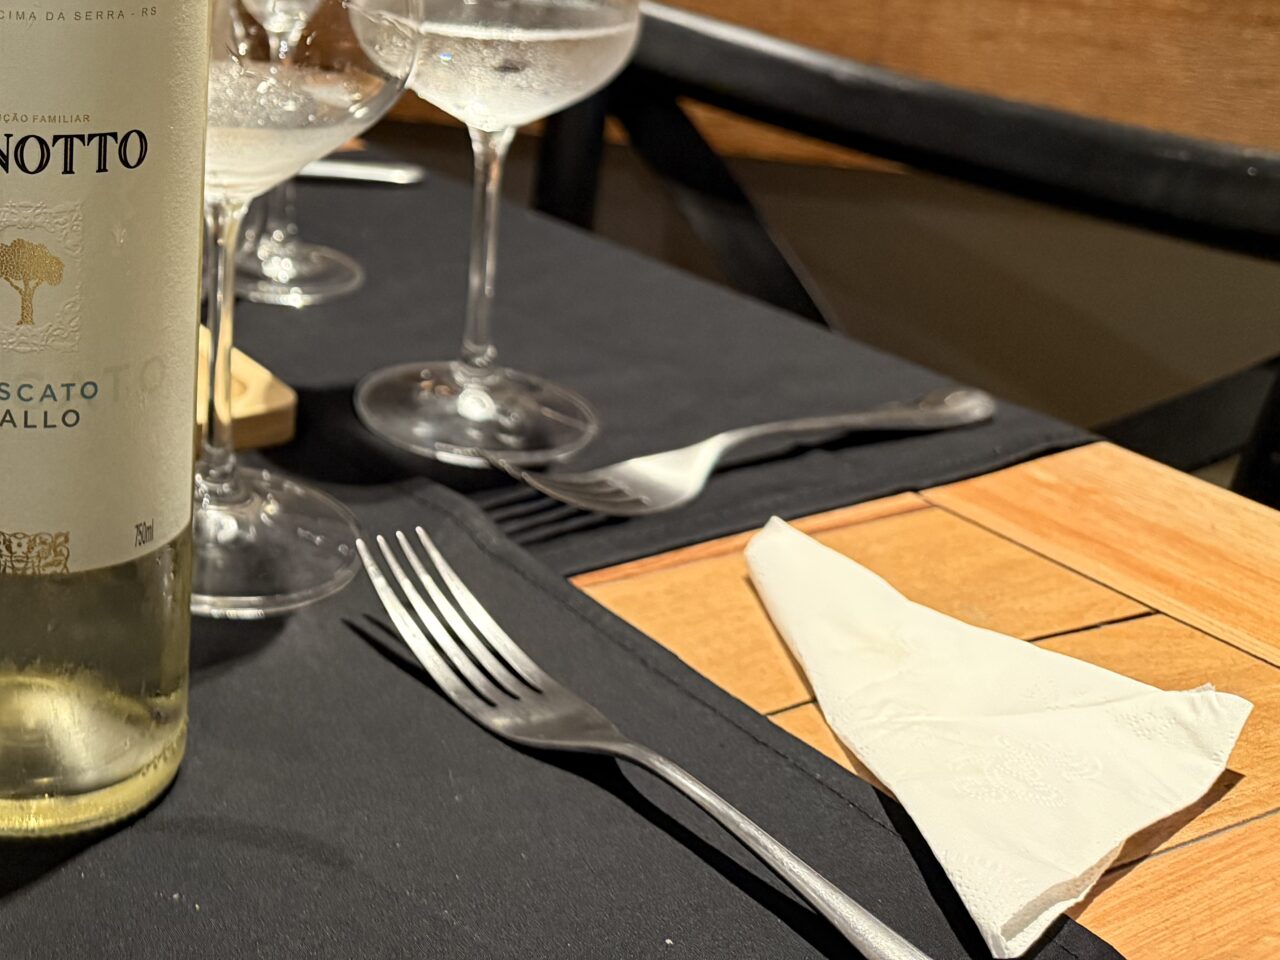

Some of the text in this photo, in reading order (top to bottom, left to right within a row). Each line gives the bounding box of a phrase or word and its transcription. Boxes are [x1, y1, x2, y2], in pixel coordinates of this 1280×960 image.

[45, 10, 66, 21] DA
[73, 9, 125, 21] SERRA
[141, 6, 158, 18] RS
[32, 113, 91, 124] FAMILIAR
[134, 518, 154, 548] 750ml
